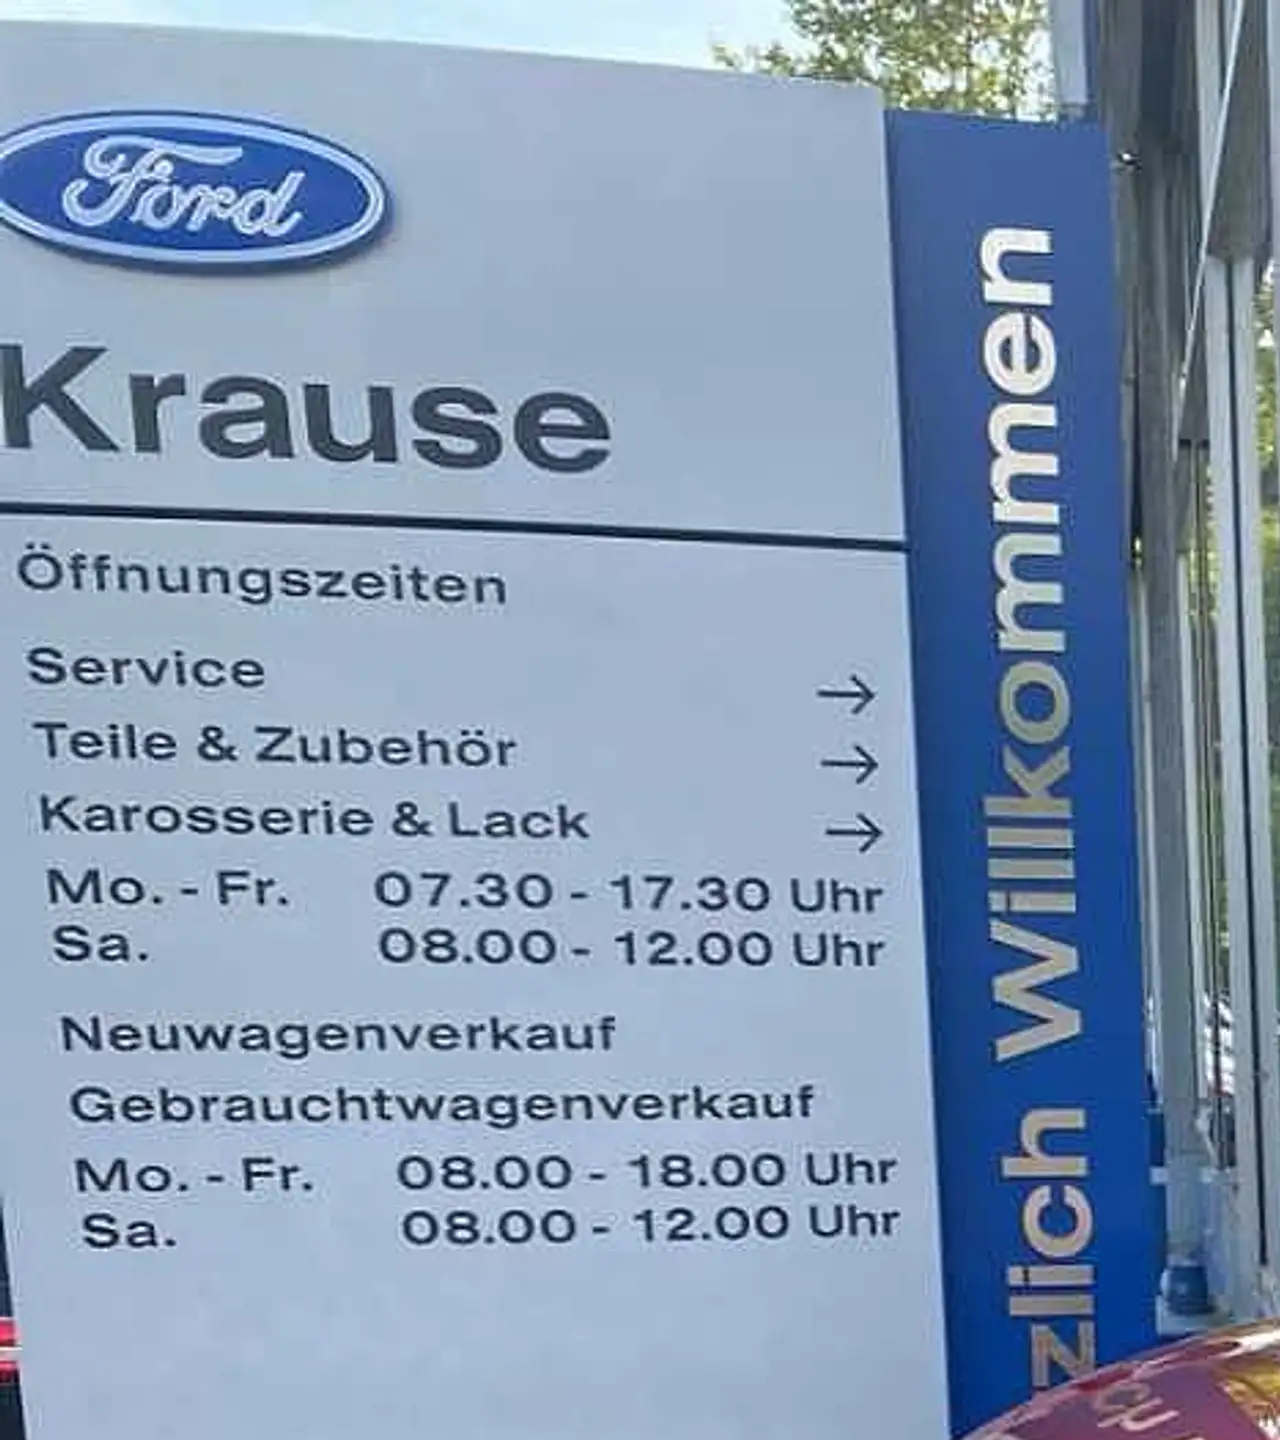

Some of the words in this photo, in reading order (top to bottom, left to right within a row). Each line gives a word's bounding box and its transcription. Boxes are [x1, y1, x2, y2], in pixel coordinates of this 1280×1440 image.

[62, 133, 305, 240] Ford
[0, 342, 613, 475] Krause
[16, 541, 507, 607] Öffnungszeiten
[980, 226, 1085, 1063] Willkommen
[25, 645, 266, 690] Service
[30, 720, 178, 762] Teile
[195, 724, 240, 763] &
[253, 724, 518, 768] Zubehör
[38, 793, 376, 837] Karosserie
[390, 800, 434, 839] &
[447, 800, 592, 840] Lack
[45, 867, 164, 906] Mo.
[215, 869, 290, 907] Fr.
[373, 869, 554, 910] 07.30
[609, 873, 772, 914] 17.30
[789, 877, 885, 914] Uhr
[52, 923, 150, 963] Sa.
[377, 926, 558, 966] 08.00
[613, 929, 774, 968] 12.00
[791, 931, 886, 968] Uhr
[59, 1014, 617, 1061] Neuwagenverkauf
[68, 1083, 816, 1131] Gebrauchtwagenverkauf
[73, 1156, 190, 1194] Mo.
[240, 1155, 314, 1193] Fr.
[395, 1153, 574, 1192] 08.00
[627, 1151, 787, 1190] 18.00
[804, 1151, 899, 1188] Uhr
[81, 1211, 178, 1250] Sa.
[401, 1208, 578, 1247] 08.00
[633, 1204, 791, 1244] 12.00
[808, 1203, 902, 1240] Uhr
